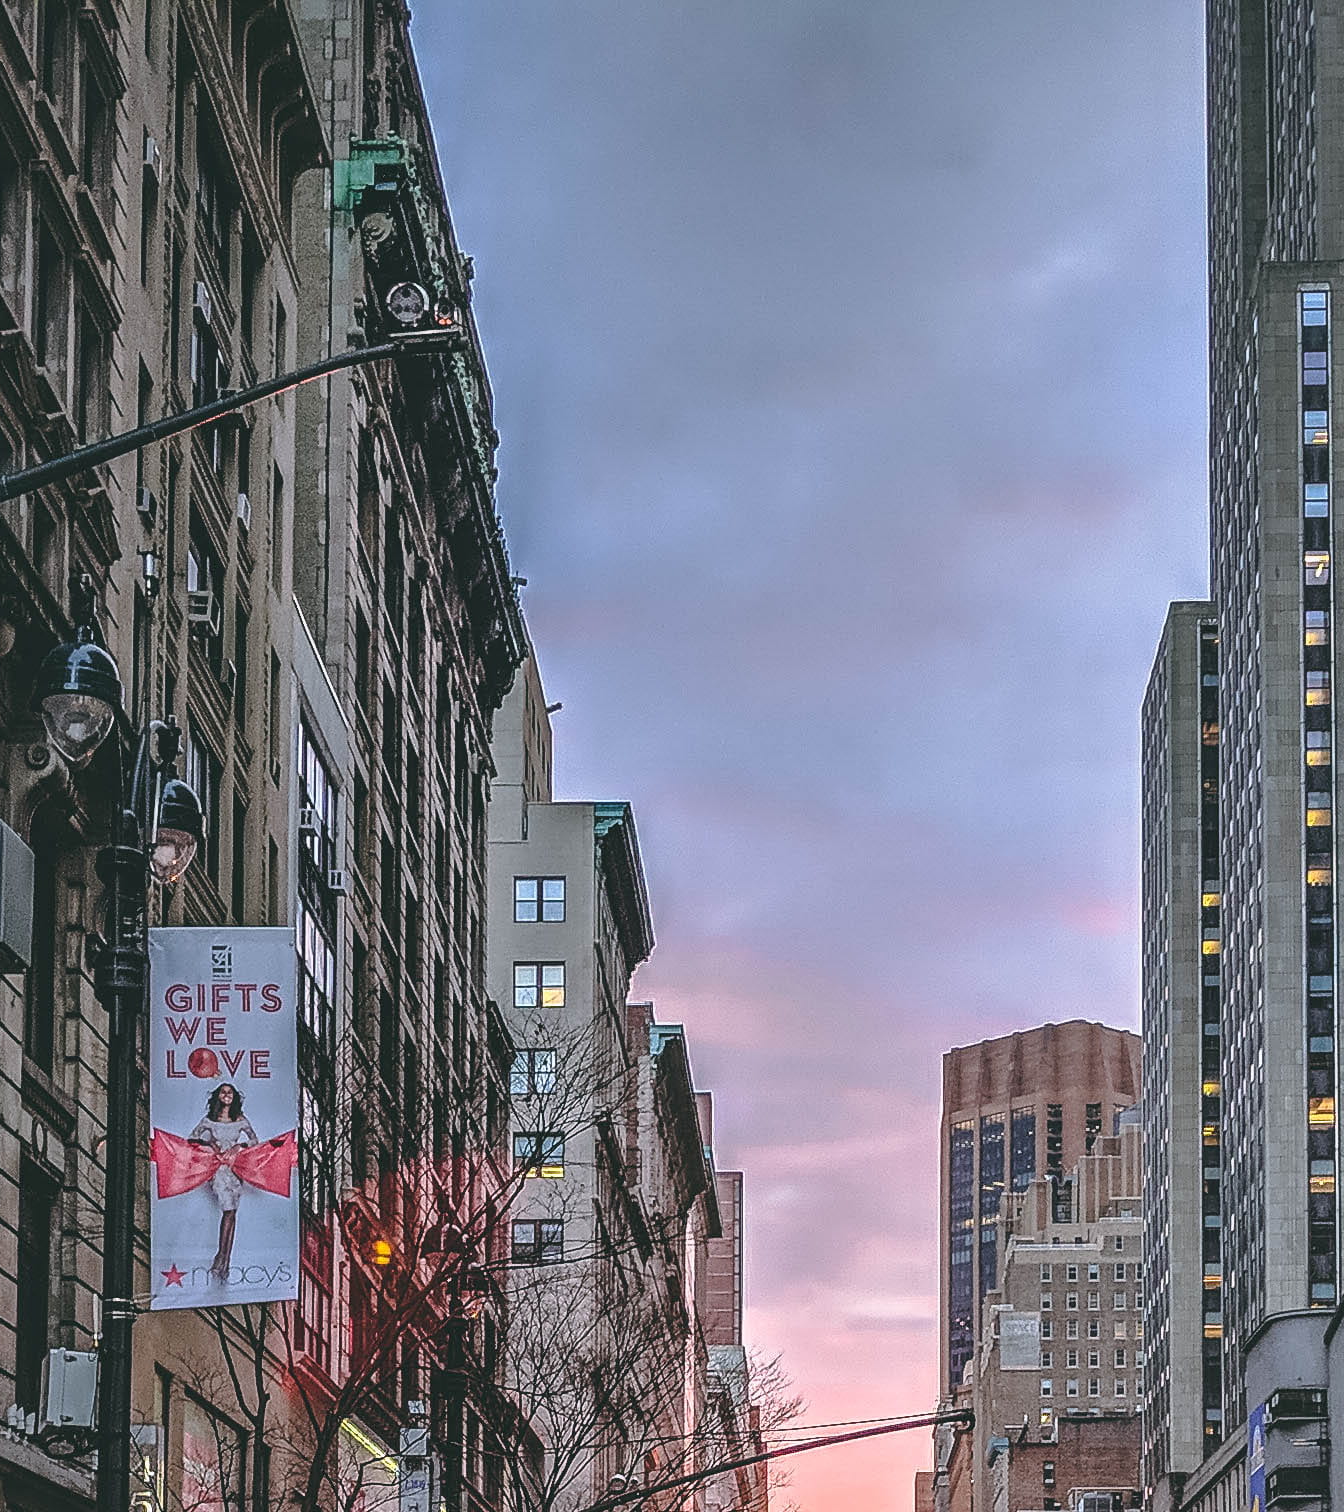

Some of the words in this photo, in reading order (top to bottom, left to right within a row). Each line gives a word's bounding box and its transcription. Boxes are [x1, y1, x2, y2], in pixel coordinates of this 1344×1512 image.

[164, 983, 283, 1013] GIFTS
[164, 1016, 228, 1046] WE
[166, 1047, 272, 1079] LOVE
[191, 1261, 293, 1289] macy's
